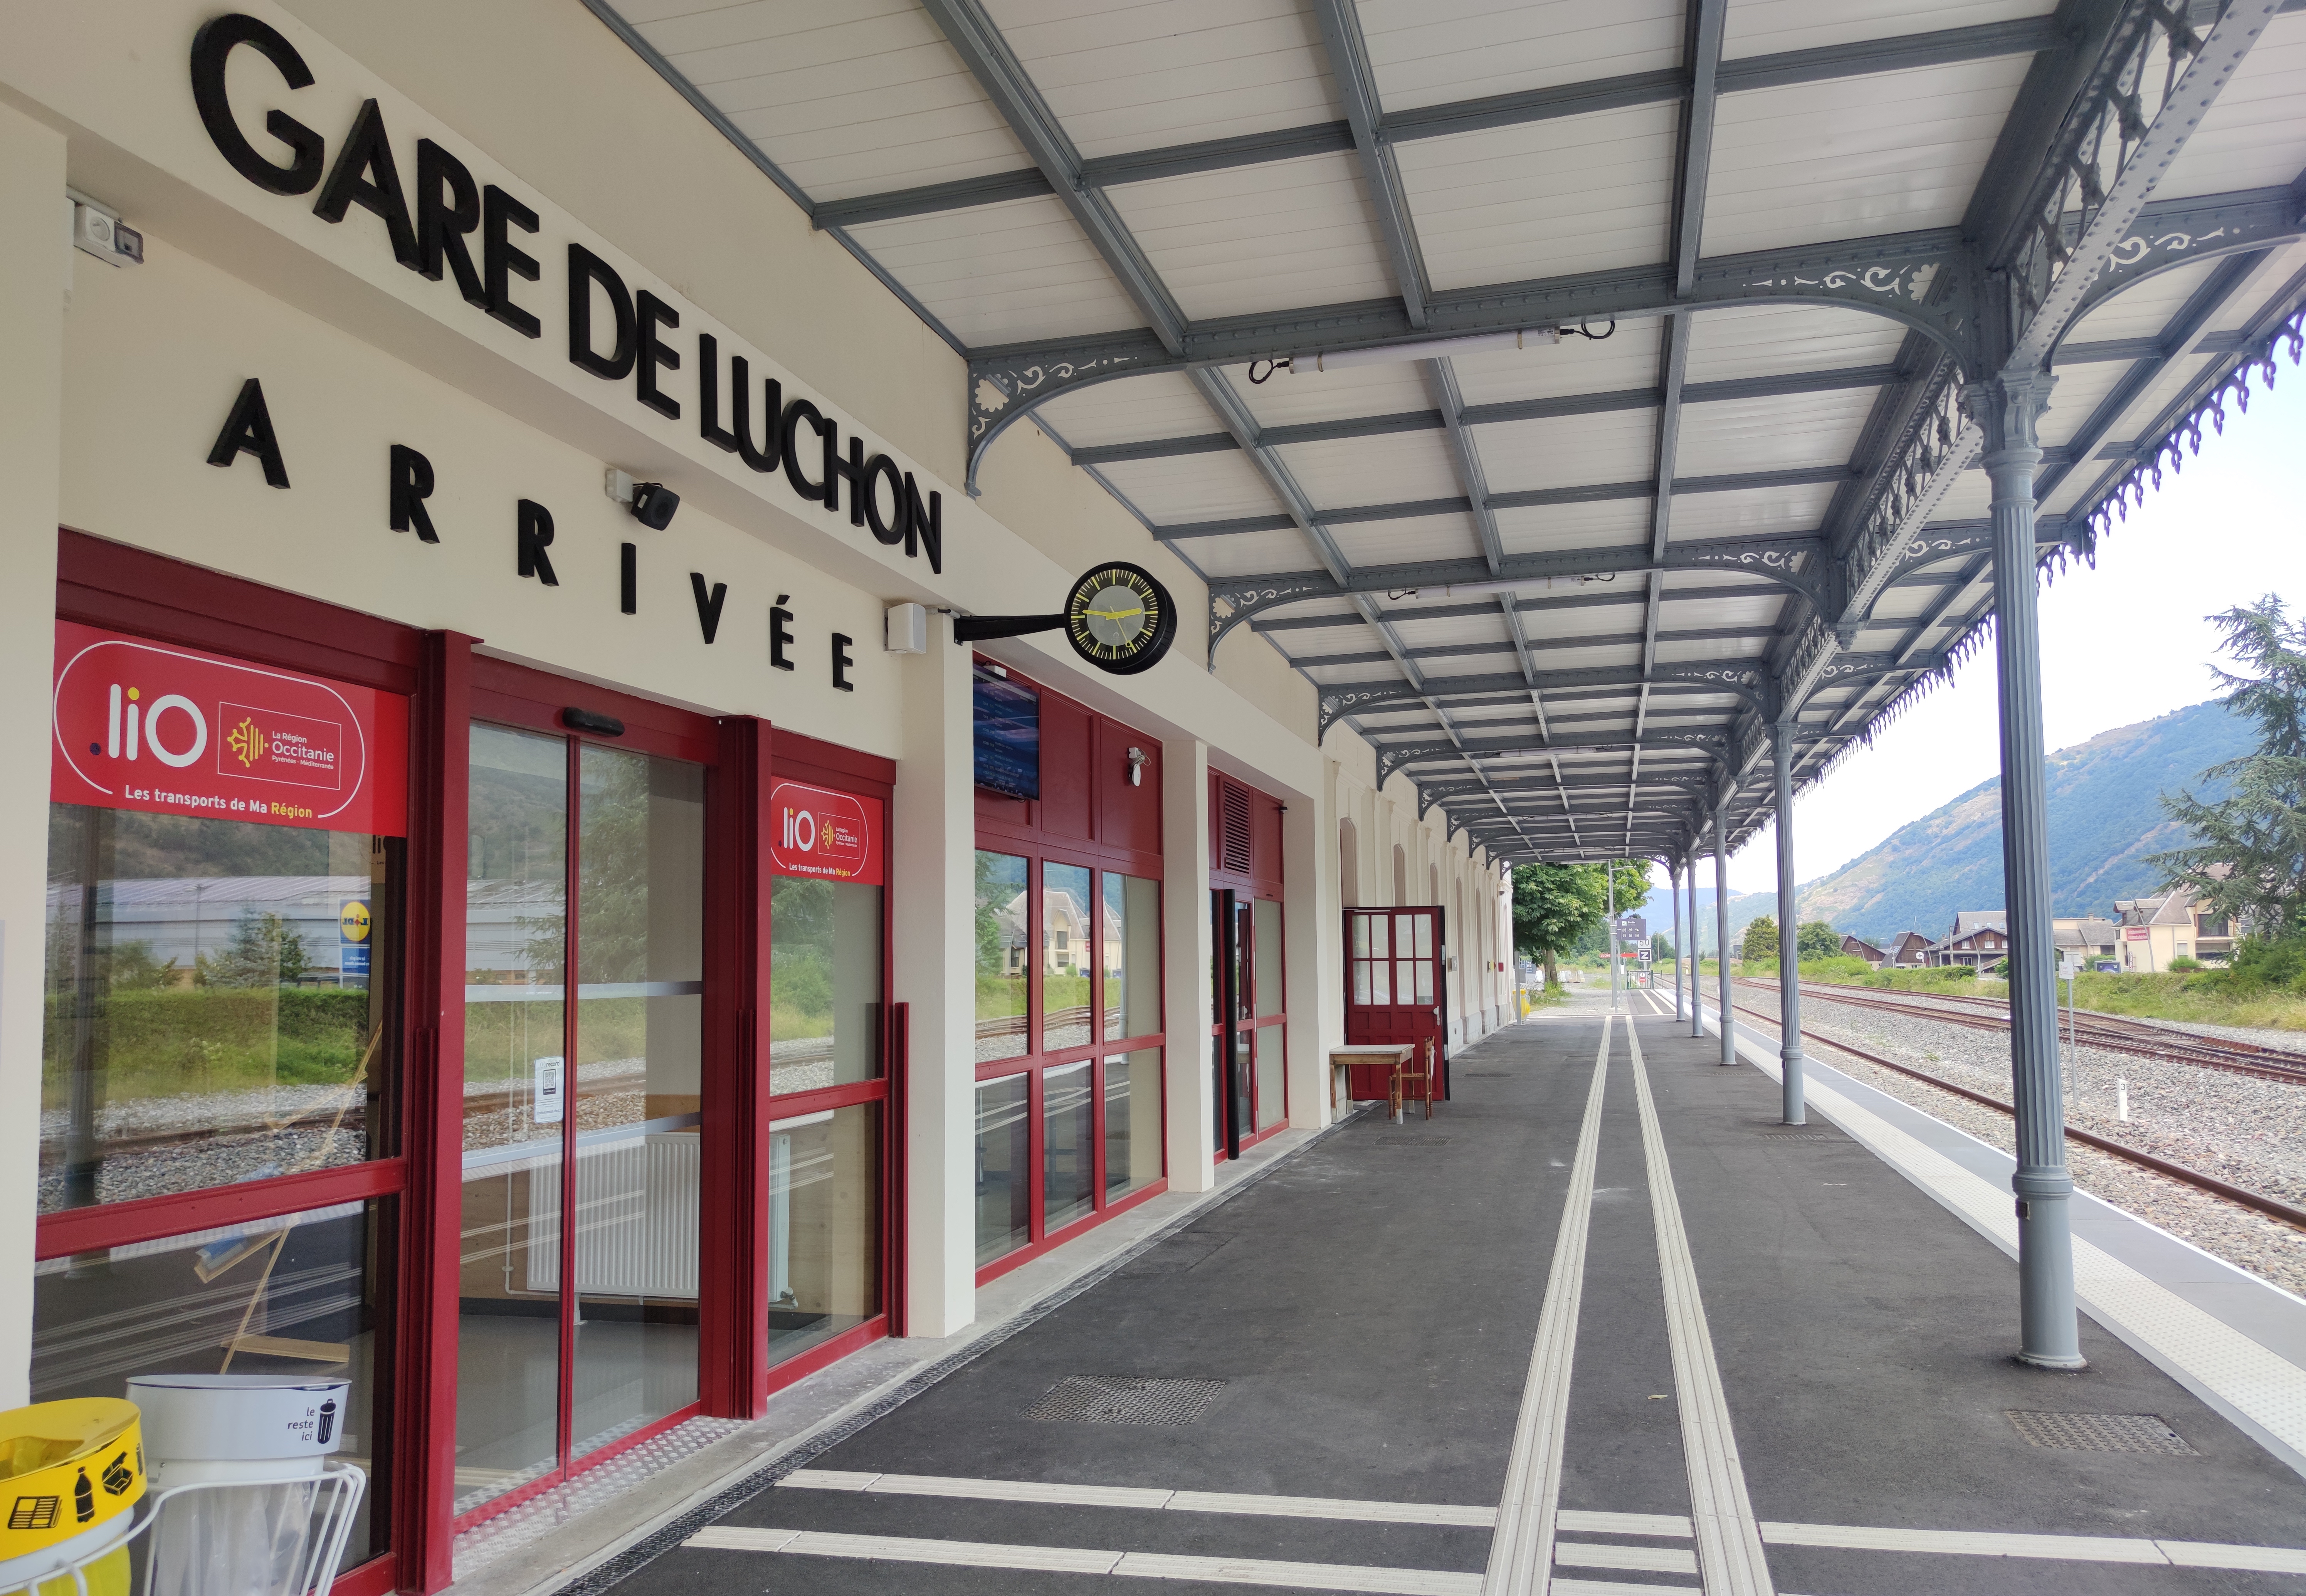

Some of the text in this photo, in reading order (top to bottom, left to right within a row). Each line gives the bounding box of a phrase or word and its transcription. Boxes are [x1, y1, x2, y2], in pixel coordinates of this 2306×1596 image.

[191, 12, 941, 575] GARE DE LUCHON
[206, 378, 854, 692] ARRIVÉE
[272, 731, 307, 744] La Région
[272, 741, 334, 762] Occitanie
[272, 755, 296, 764] Pyrénées
[300, 759, 334, 769] Méditerranée
[125, 785, 312, 819] Les transports de Ma Région
[836, 832, 857, 843] Occitanie
[789, 862, 797, 871] Les
[798, 863, 822, 874] transports
[829, 867, 835, 875] Ma
[836, 868, 850, 878] Région
[1641, 951, 1649, 959] Z
[306, 1407, 315, 1416] le
[287, 1419, 314, 1430] reste
[302, 1430, 313, 1441] ici
